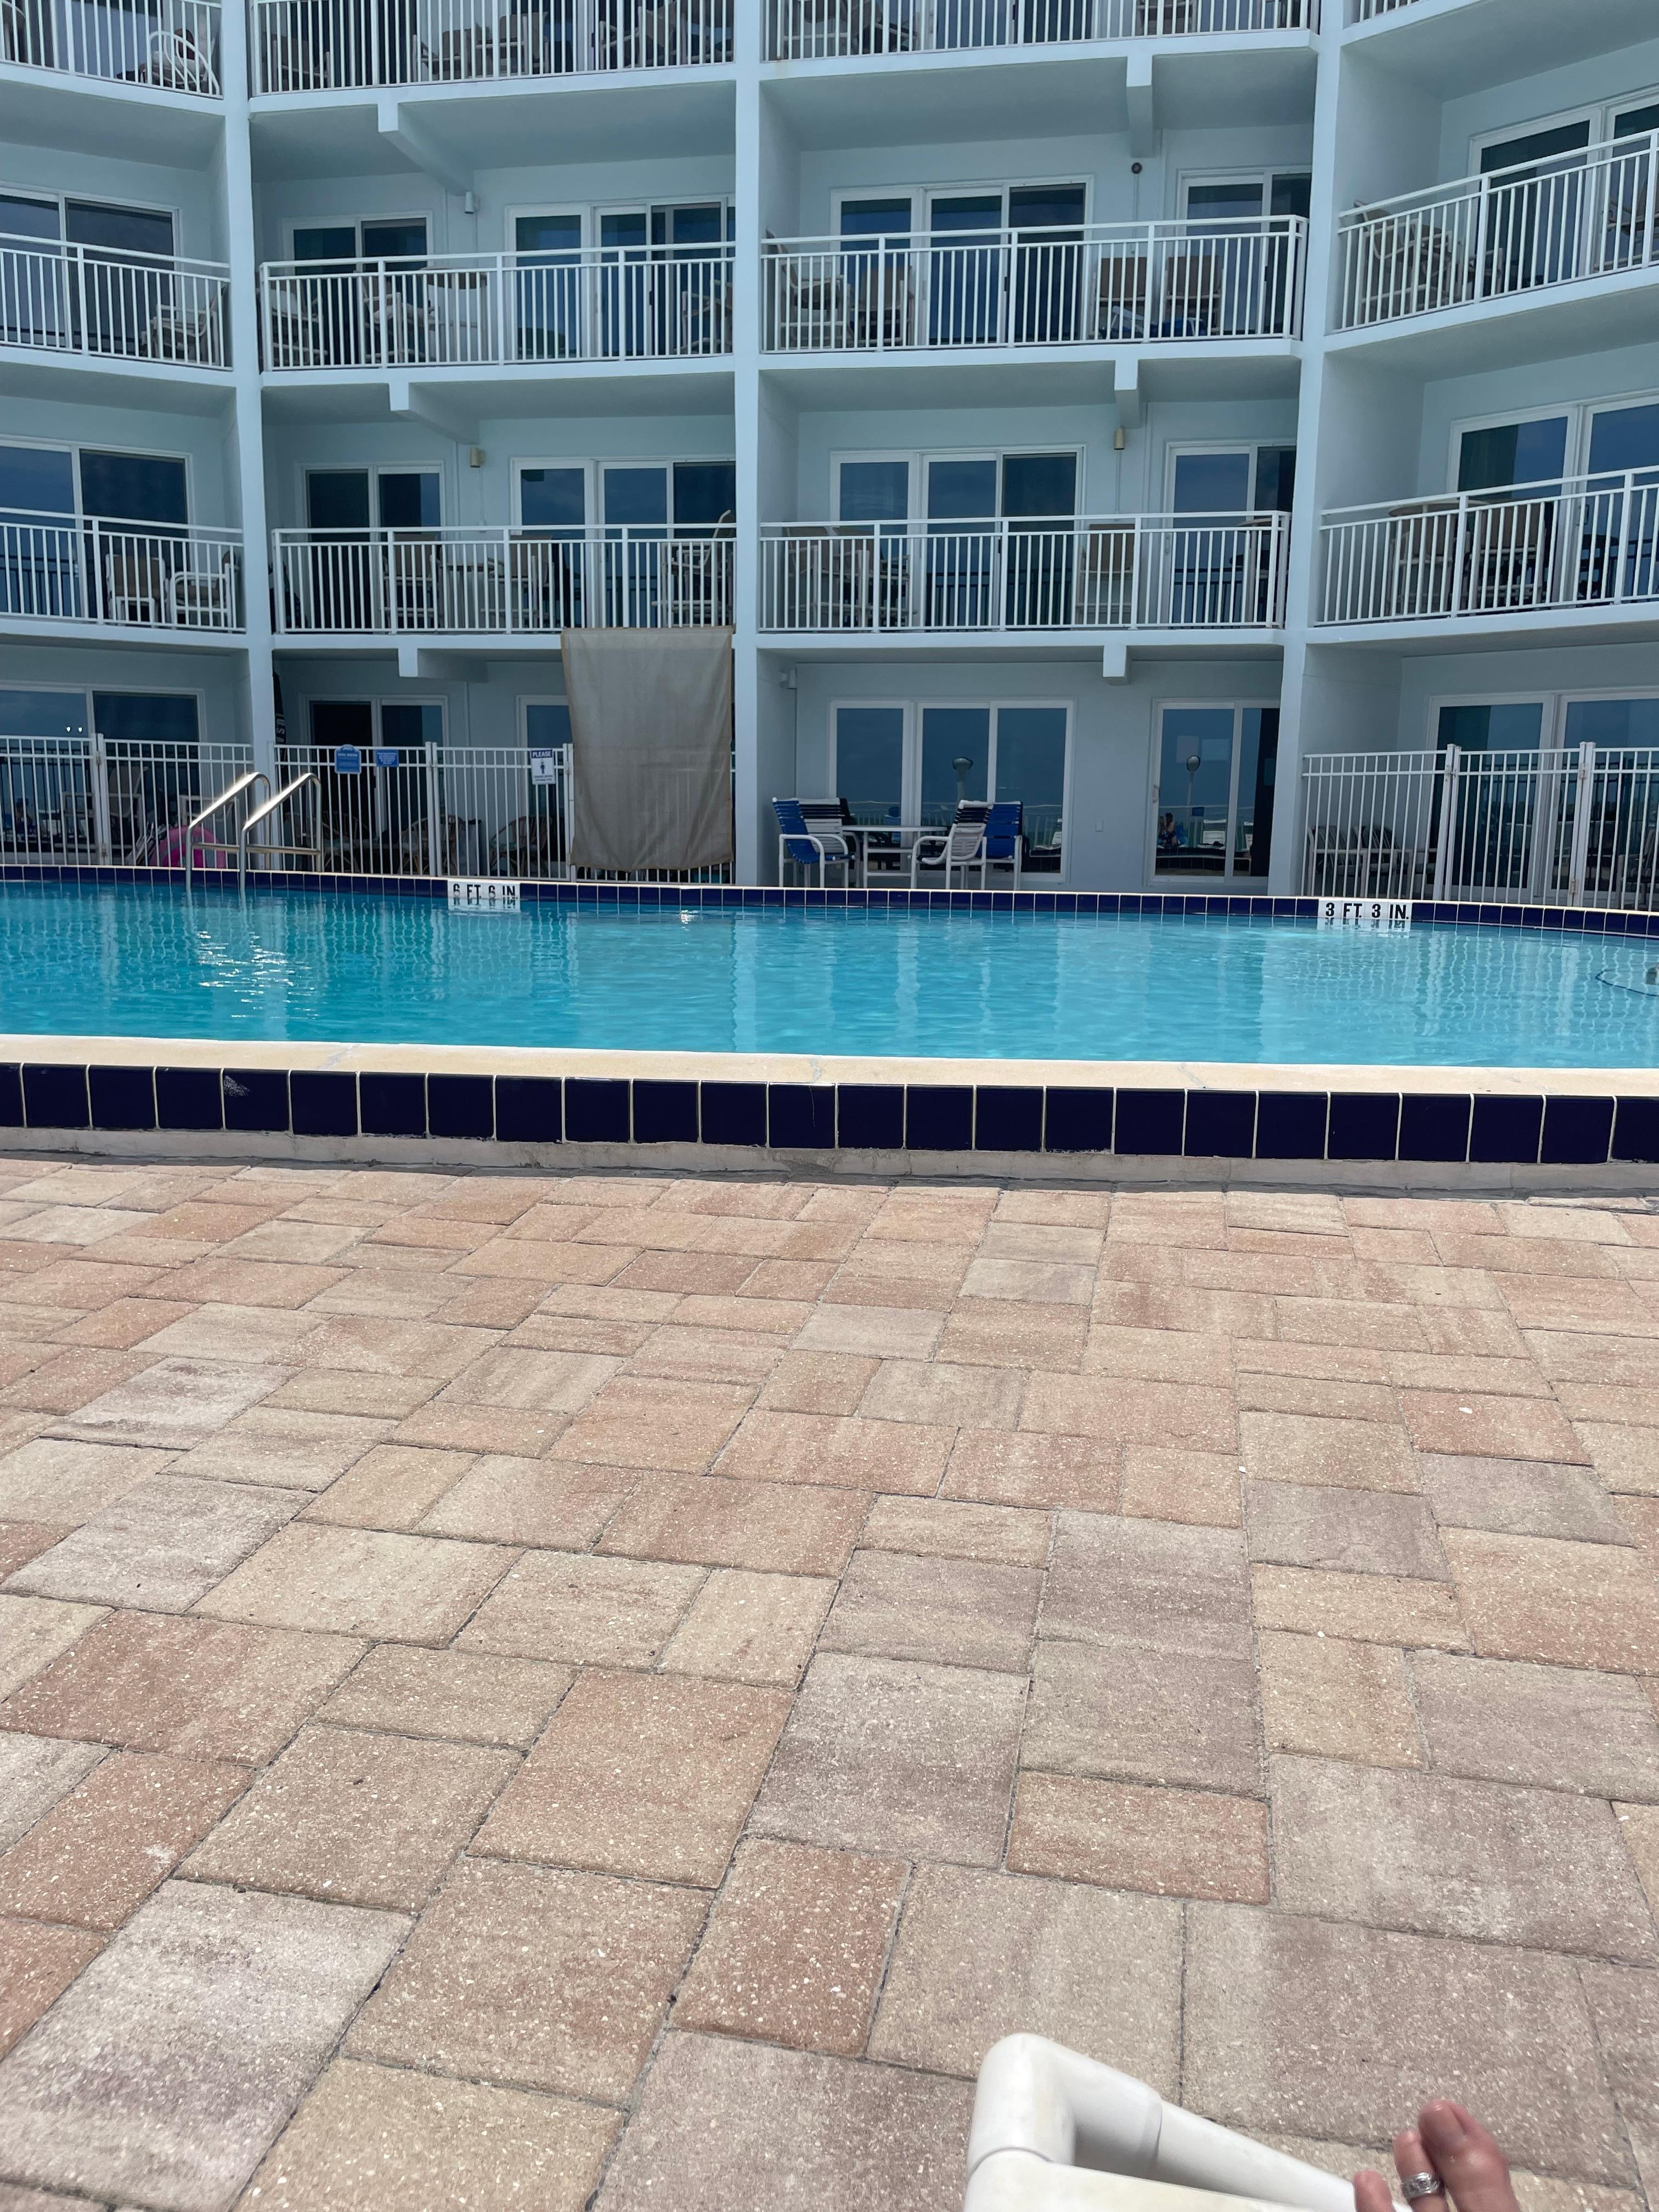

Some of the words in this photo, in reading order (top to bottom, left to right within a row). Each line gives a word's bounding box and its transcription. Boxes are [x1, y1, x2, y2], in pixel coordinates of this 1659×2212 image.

[453, 883, 460, 897] 6
[488, 885, 495, 899] 6
[1325, 902, 1335, 917] 3
[1344, 902, 1362, 918] FT.
[1372, 904, 1381, 918] 3
[1389, 904, 1409, 919] IN.
